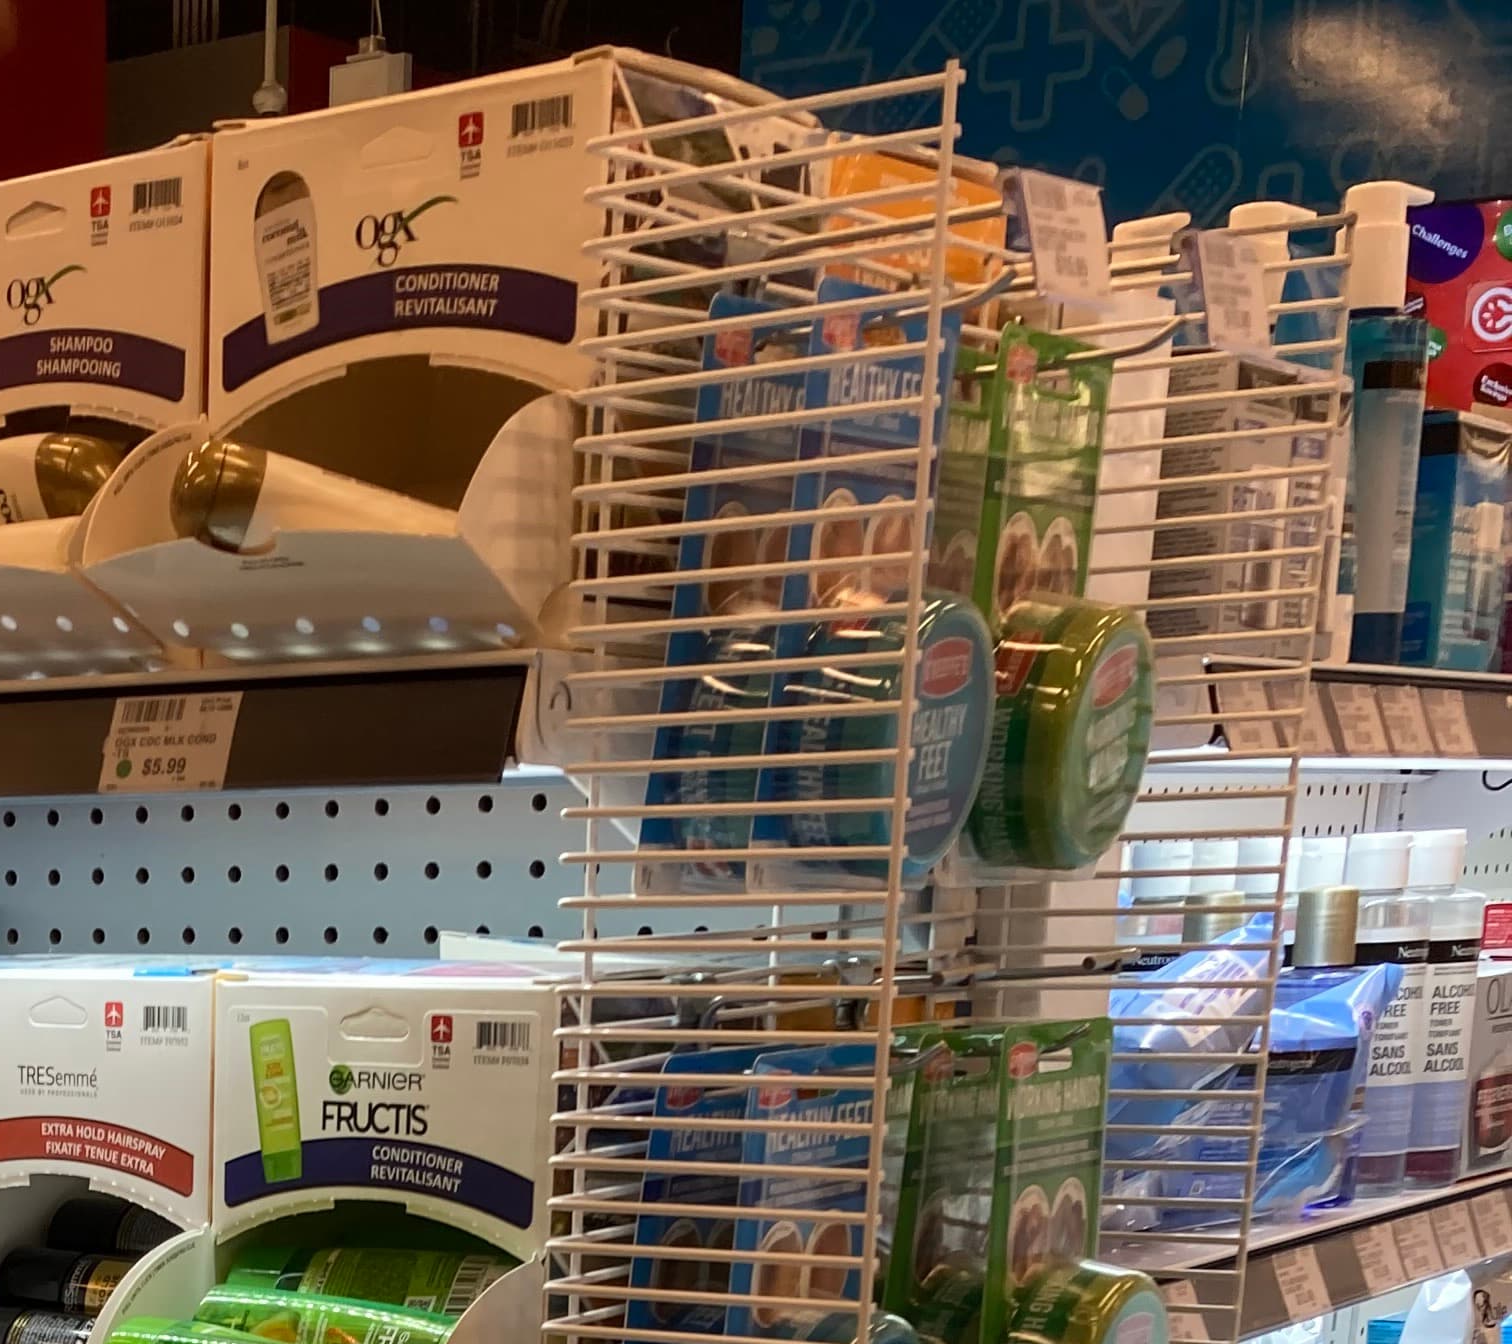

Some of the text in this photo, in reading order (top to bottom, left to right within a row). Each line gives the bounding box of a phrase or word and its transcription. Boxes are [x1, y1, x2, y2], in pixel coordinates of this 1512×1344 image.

[355, 202, 440, 267] ogx
[1412, 224, 1468, 259] Challenges
[396, 272, 499, 292] CONDITIONER
[6, 270, 73, 325] ogx
[395, 298, 496, 318] REVITALISANT
[50, 337, 113, 353] SHAMPOO
[37, 359, 121, 378] SHAMPOOING
[142, 757, 186, 776] $5.99
[916, 740, 952, 786] FEET
[1430, 1001, 1460, 1015] FREE
[1372, 1045, 1405, 1060] SANS
[1427, 1042, 1459, 1056] SANS
[18, 1065, 98, 1088] TRESemmé
[330, 1070, 423, 1091] GARNIER
[322, 1101, 429, 1136] FRUCTIS
[42, 1122, 166, 1160] EXTRA HOLD HAIRSPRAY
[46, 1141, 154, 1176] FIXATIF TENUE EXTRA
[372, 1145, 463, 1175] CONDITIONER
[371, 1165, 461, 1193] REVITALISANT
